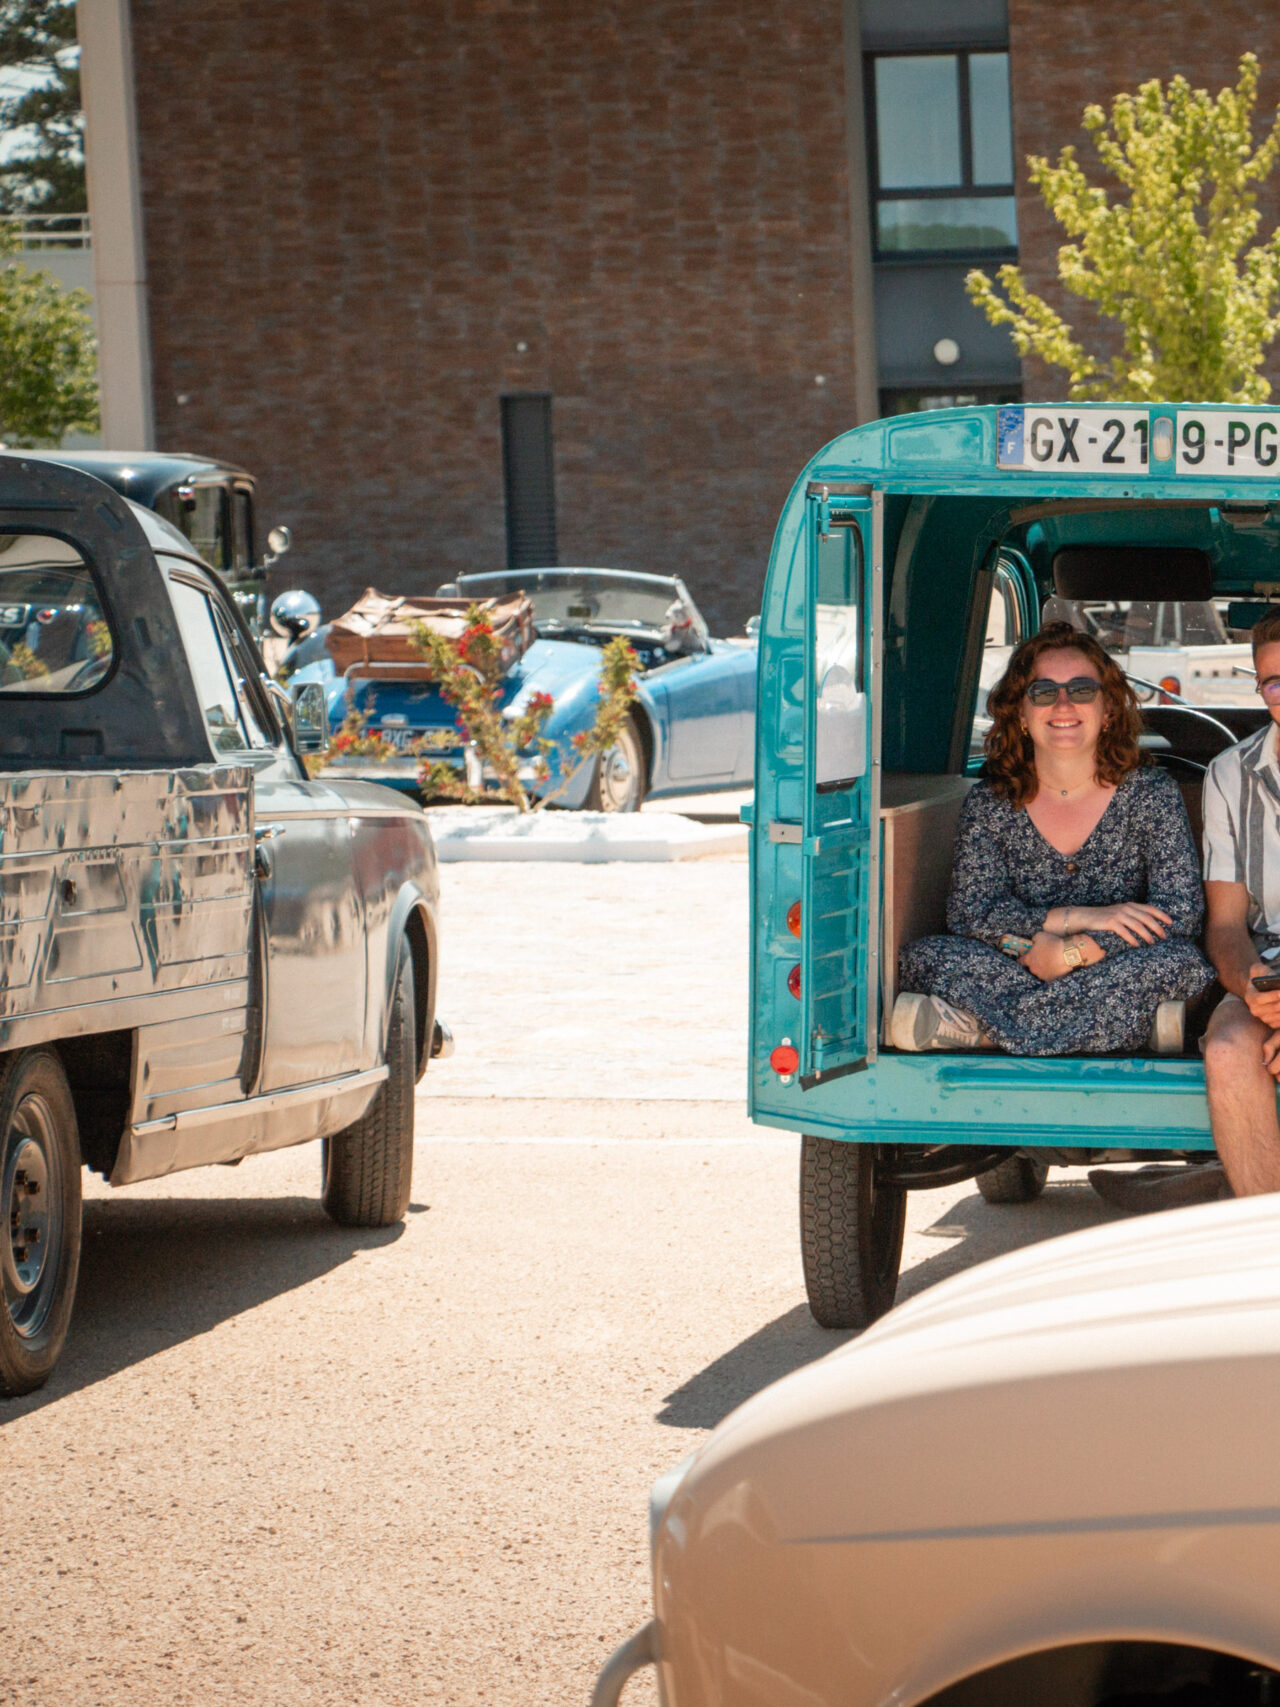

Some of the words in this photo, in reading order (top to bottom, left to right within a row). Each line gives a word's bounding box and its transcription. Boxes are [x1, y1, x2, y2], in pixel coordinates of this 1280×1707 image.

[1007, 441, 1016, 454] F
[1030, 417, 1148, 465] GX-21
[1182, 419, 1278, 467] 9-PG
